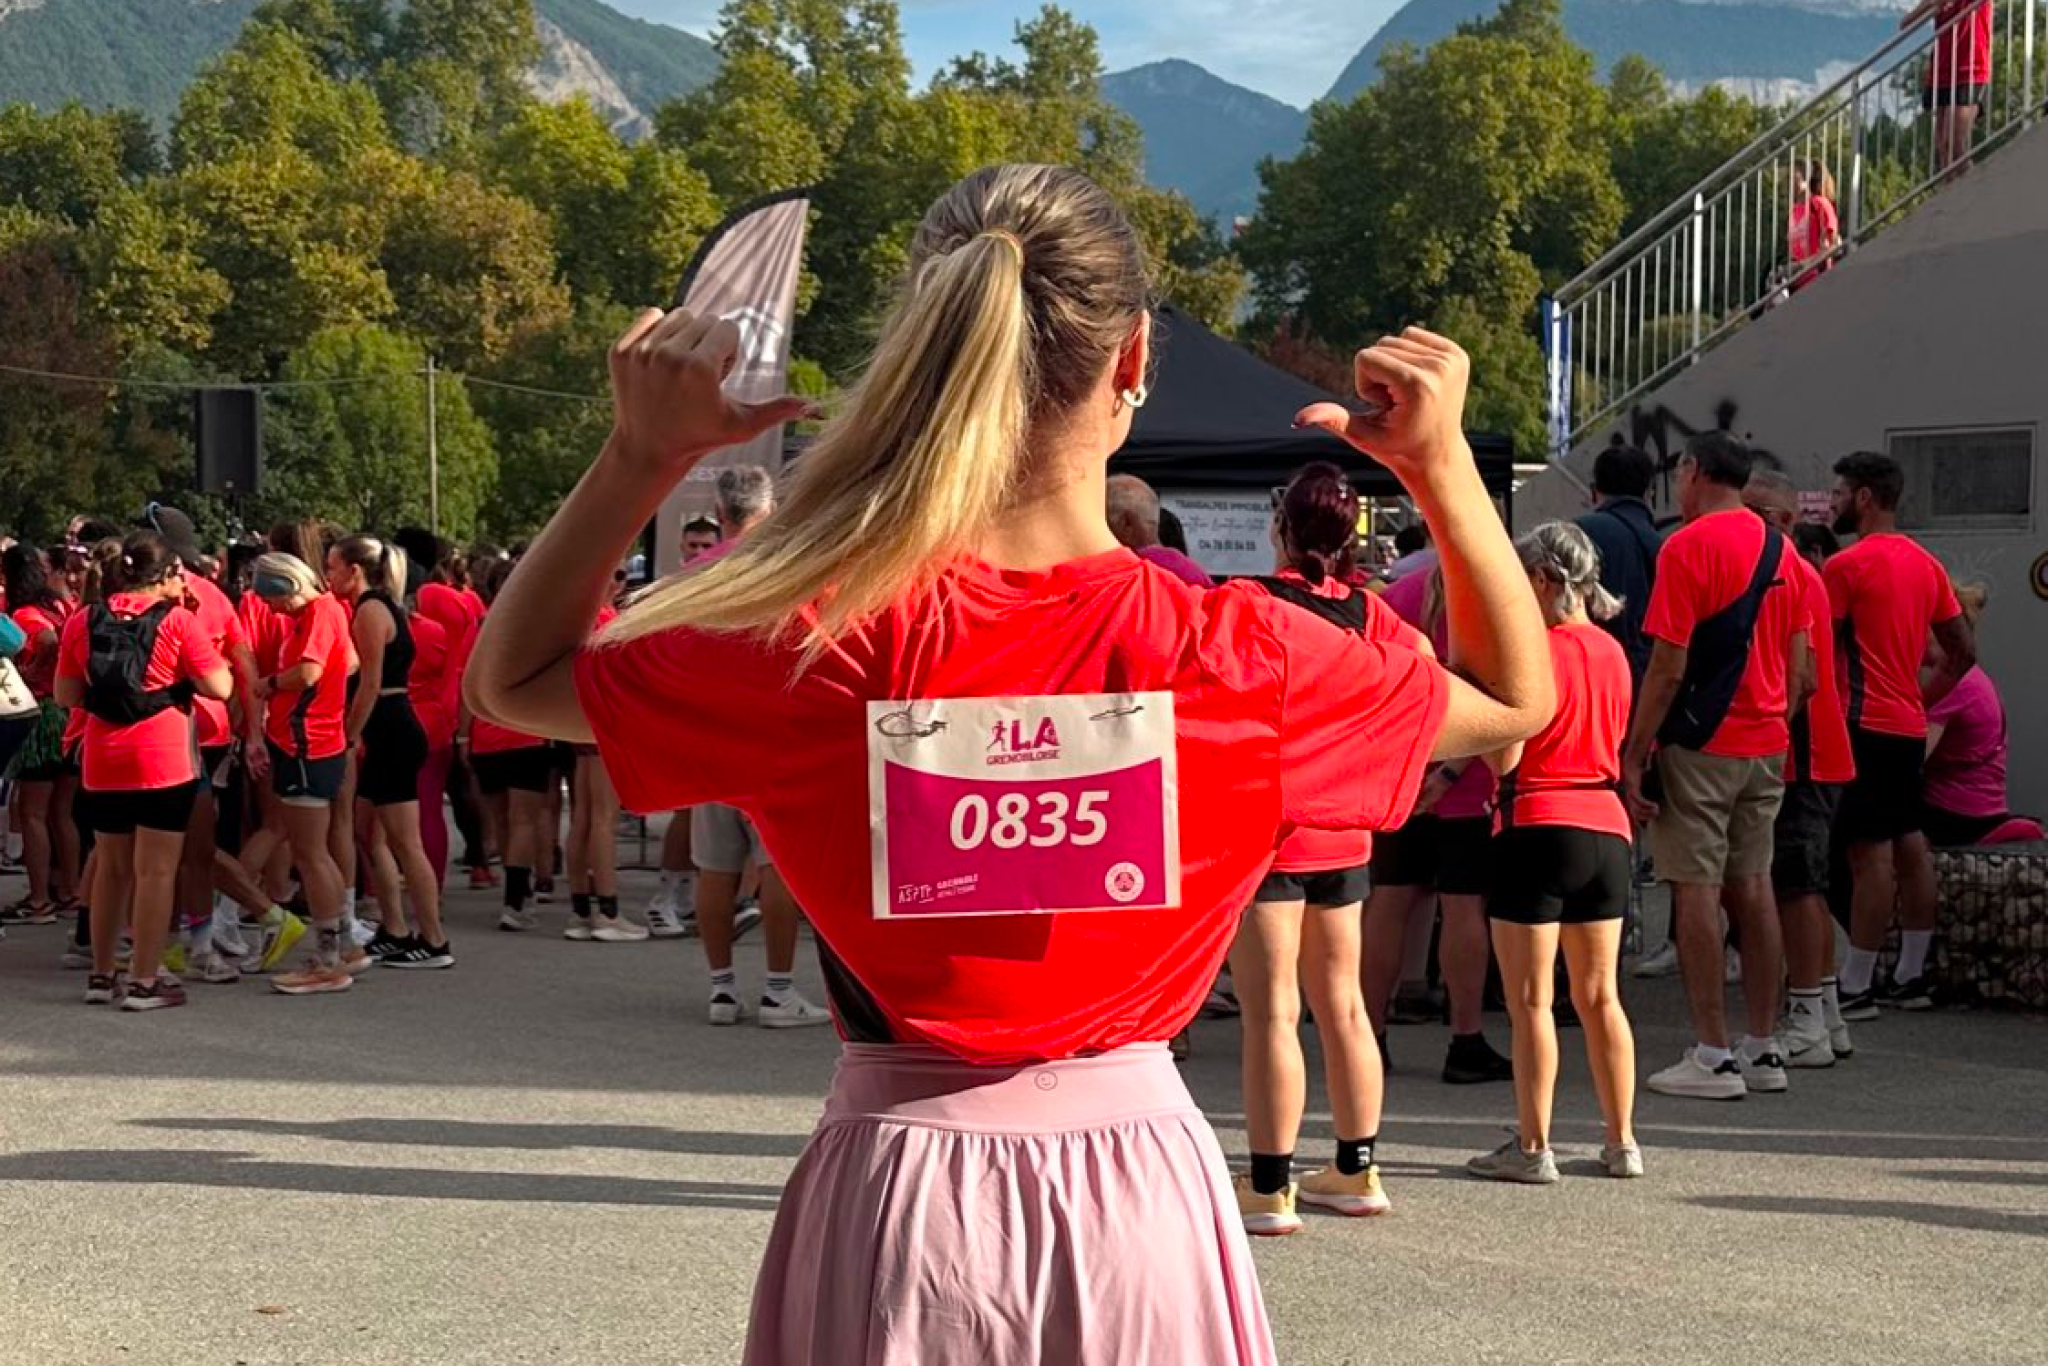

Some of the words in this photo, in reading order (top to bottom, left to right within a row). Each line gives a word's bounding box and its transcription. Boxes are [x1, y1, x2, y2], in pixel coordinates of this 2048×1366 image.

[1011, 716, 1060, 751] LA
[986, 749, 1061, 766] GRENOBLOISE
[951, 789, 1110, 850] 0835
